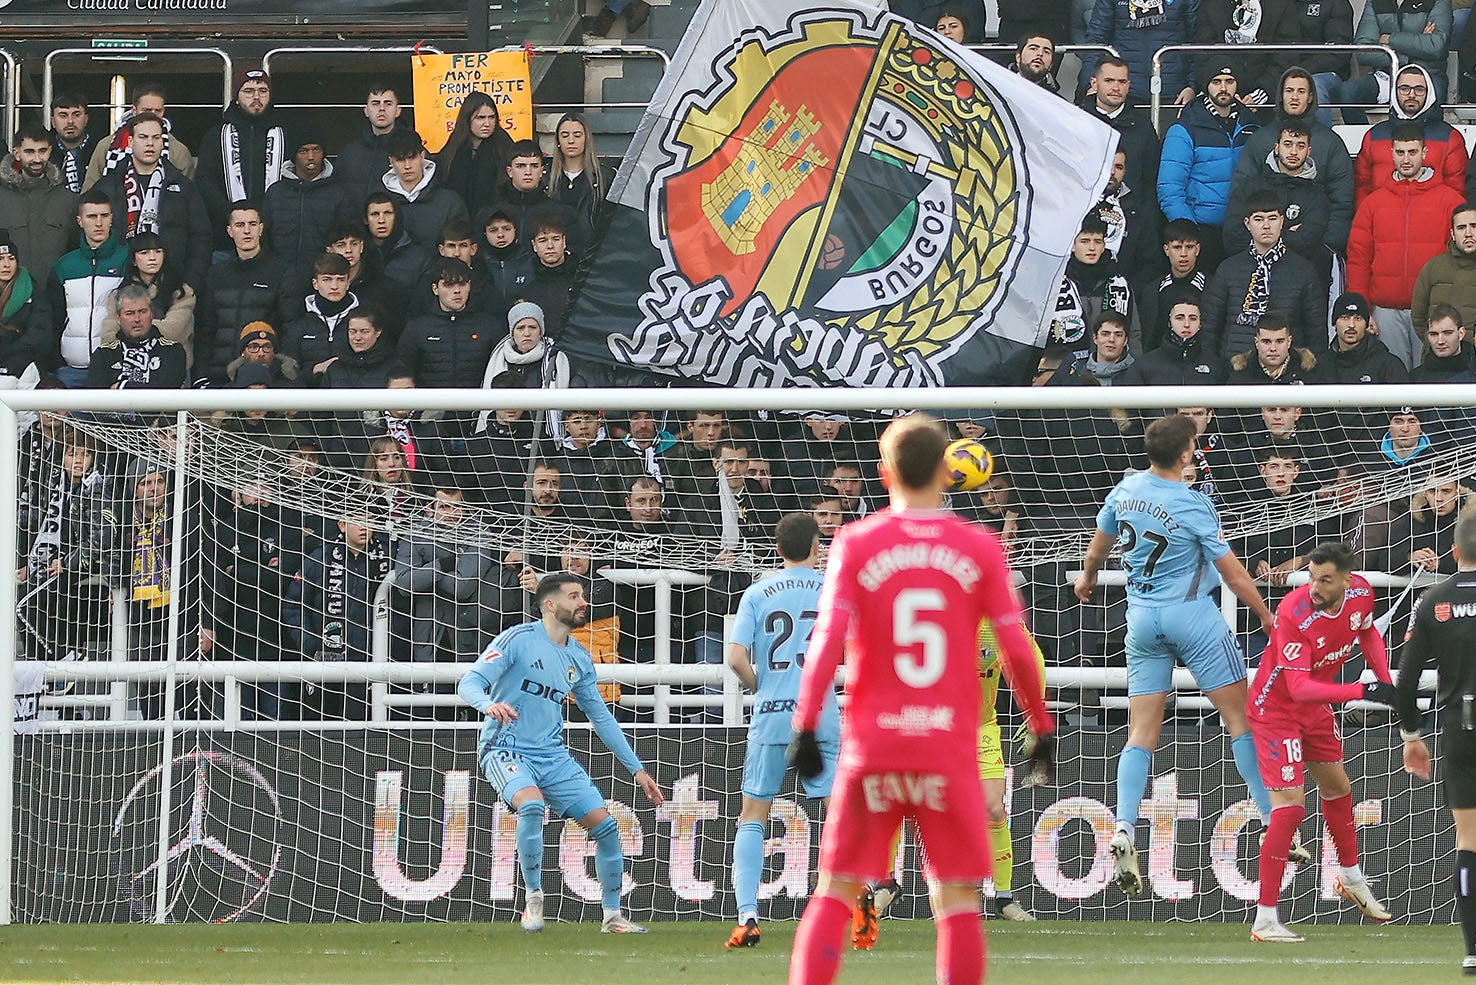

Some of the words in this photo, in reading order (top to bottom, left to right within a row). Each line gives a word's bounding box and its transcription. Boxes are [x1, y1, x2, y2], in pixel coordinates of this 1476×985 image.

[452, 54, 488, 68] FER
[445, 71, 481, 81] MAYO
[1117, 499, 1146, 514] DAVID
[1147, 503, 1180, 534] LÓPEZ
[1118, 520, 1169, 578] 27
[763, 579, 825, 598] MORANT
[893, 588, 947, 688] 5
[1282, 738, 1303, 762] 18
